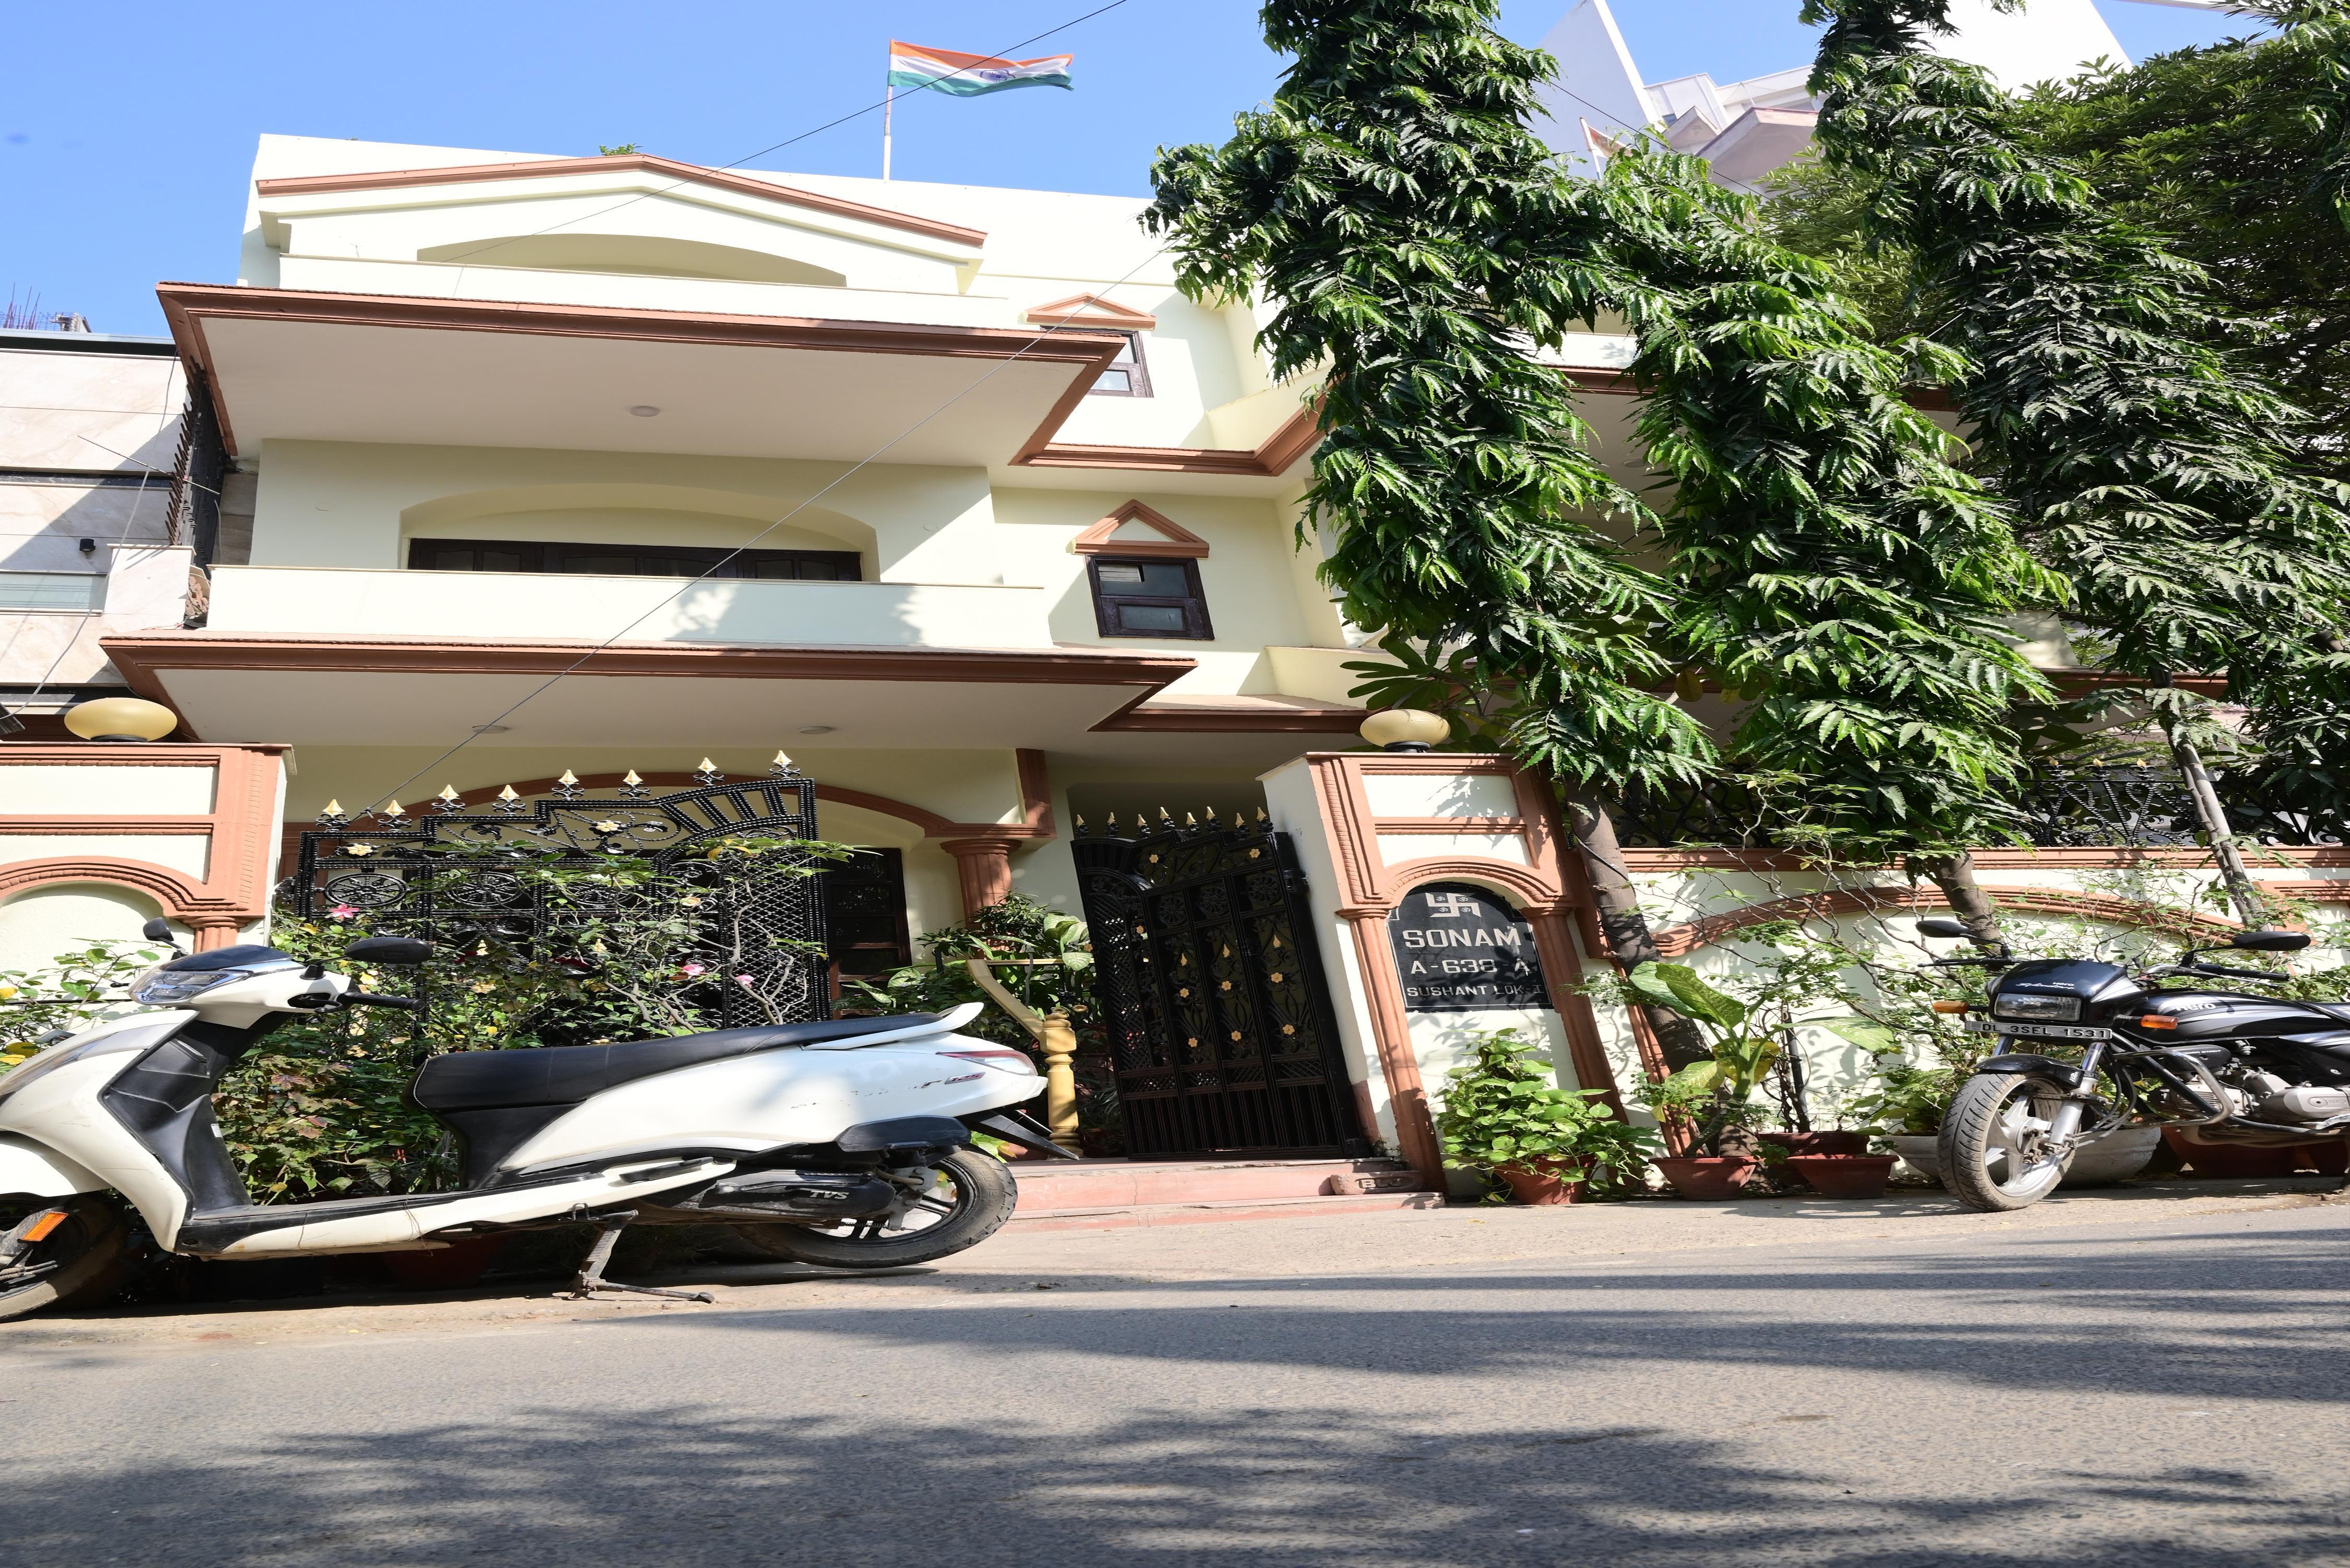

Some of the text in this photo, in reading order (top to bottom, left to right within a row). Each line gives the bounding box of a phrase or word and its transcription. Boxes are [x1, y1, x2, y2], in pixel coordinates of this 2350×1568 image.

[1402, 928, 1521, 948] SONAM
[1406, 985, 1487, 997] SUSHANT
[2175, 1003, 2216, 1011] Hero
[1982, 1023, 2107, 1038] DL 3SEL 1531
[951, 1073, 982, 1082] 125
[809, 1190, 850, 1199] TVS
